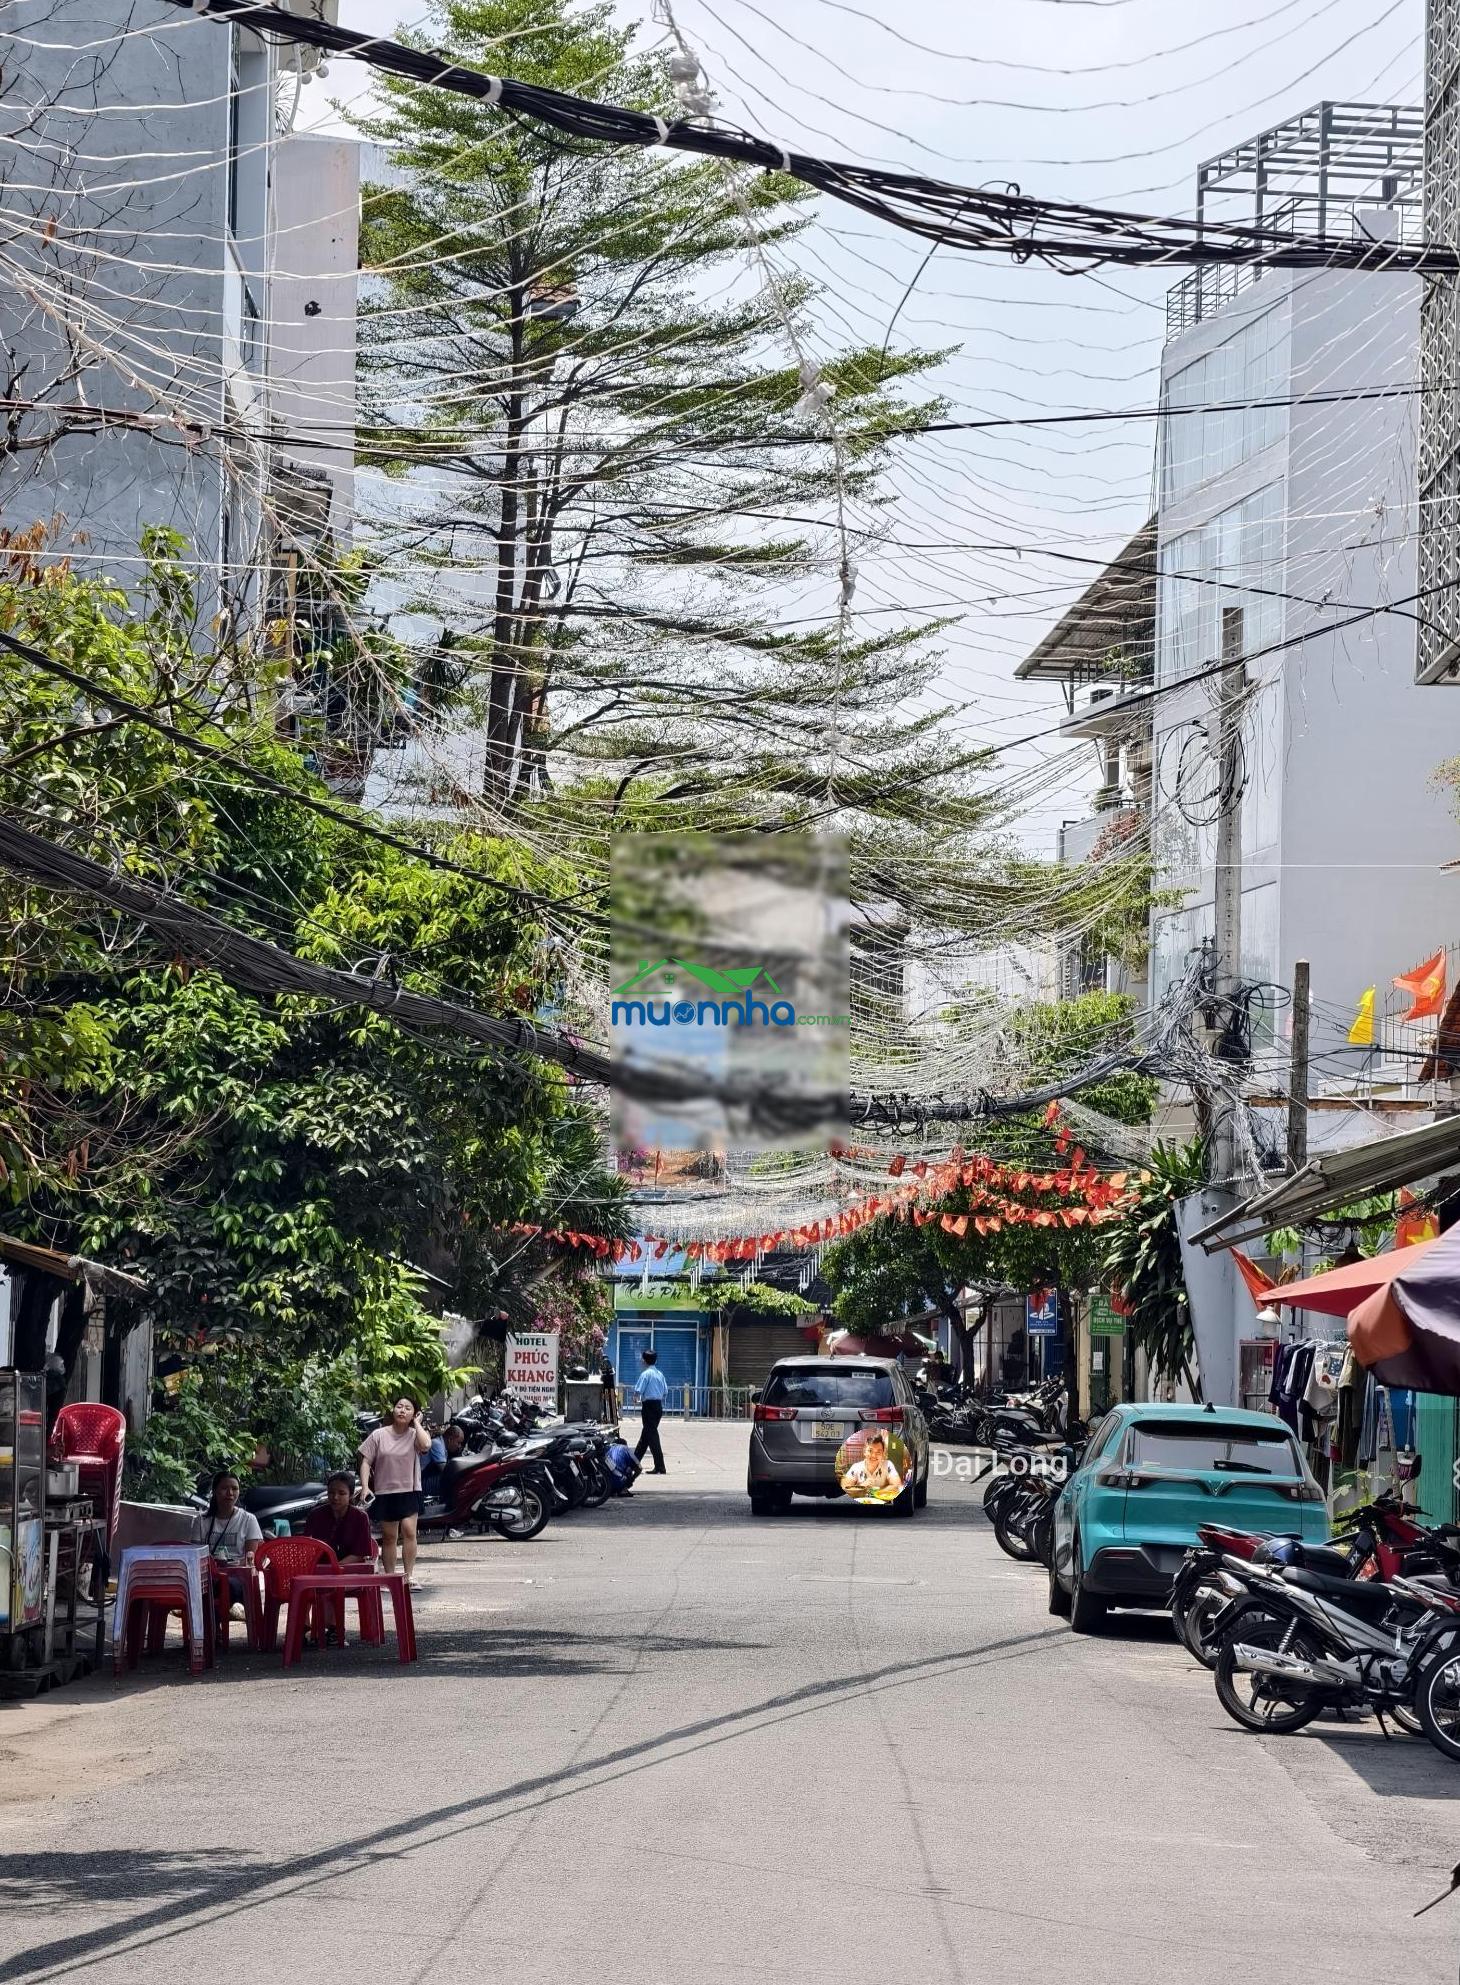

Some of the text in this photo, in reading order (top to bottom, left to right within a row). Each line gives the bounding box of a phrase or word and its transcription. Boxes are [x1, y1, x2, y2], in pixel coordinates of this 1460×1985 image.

[516, 1337, 548, 1346] HOTEL
[514, 1348, 550, 1364] PHÚC
[507, 1369, 555, 1382] KHANG
